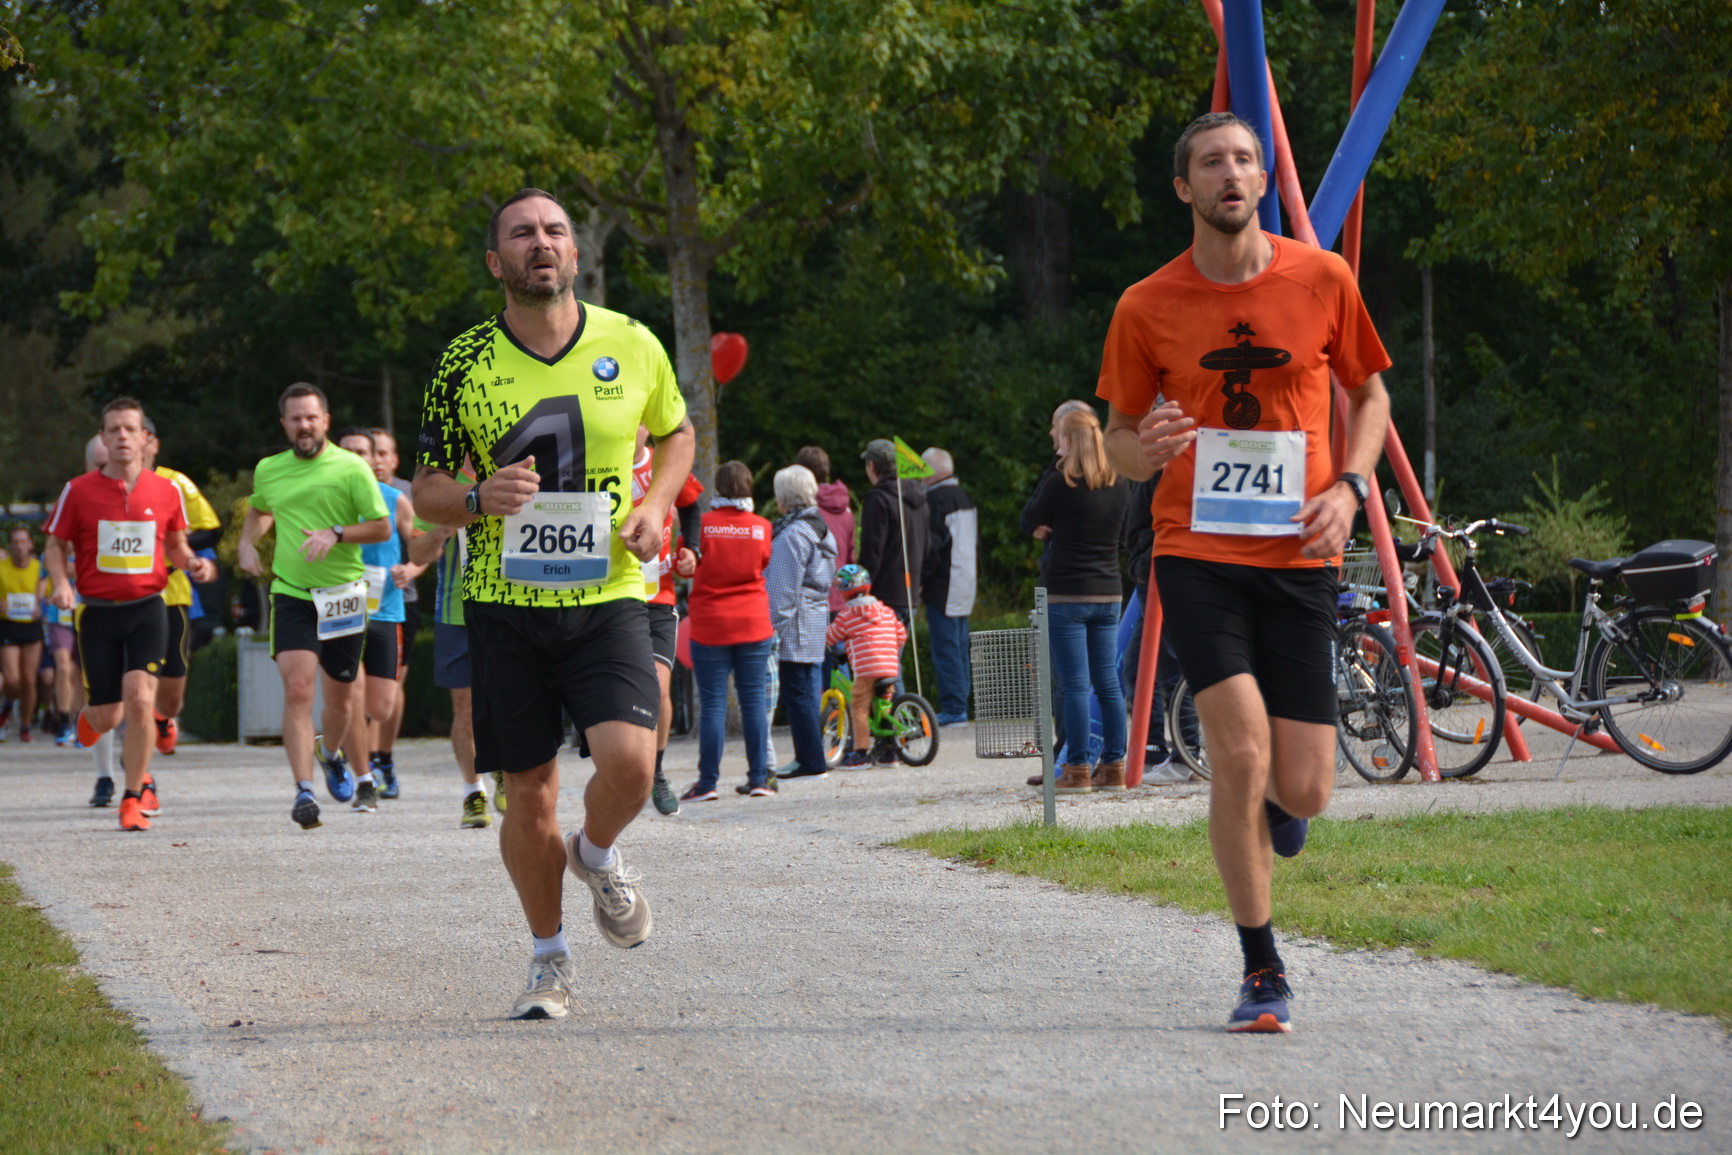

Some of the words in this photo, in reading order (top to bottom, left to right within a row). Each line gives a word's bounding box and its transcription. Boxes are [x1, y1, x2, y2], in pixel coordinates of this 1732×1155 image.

[594, 384, 624, 396] Partl
[1239, 440, 1277, 450] BOCK
[1211, 462, 1284, 494] 2741
[544, 502, 582, 510] BOCK
[703, 525, 750, 535] raumbox
[520, 524, 595, 553] 2664
[112, 537, 142, 553] 402
[543, 564, 571, 575] Erich
[325, 597, 359, 617] 2190
